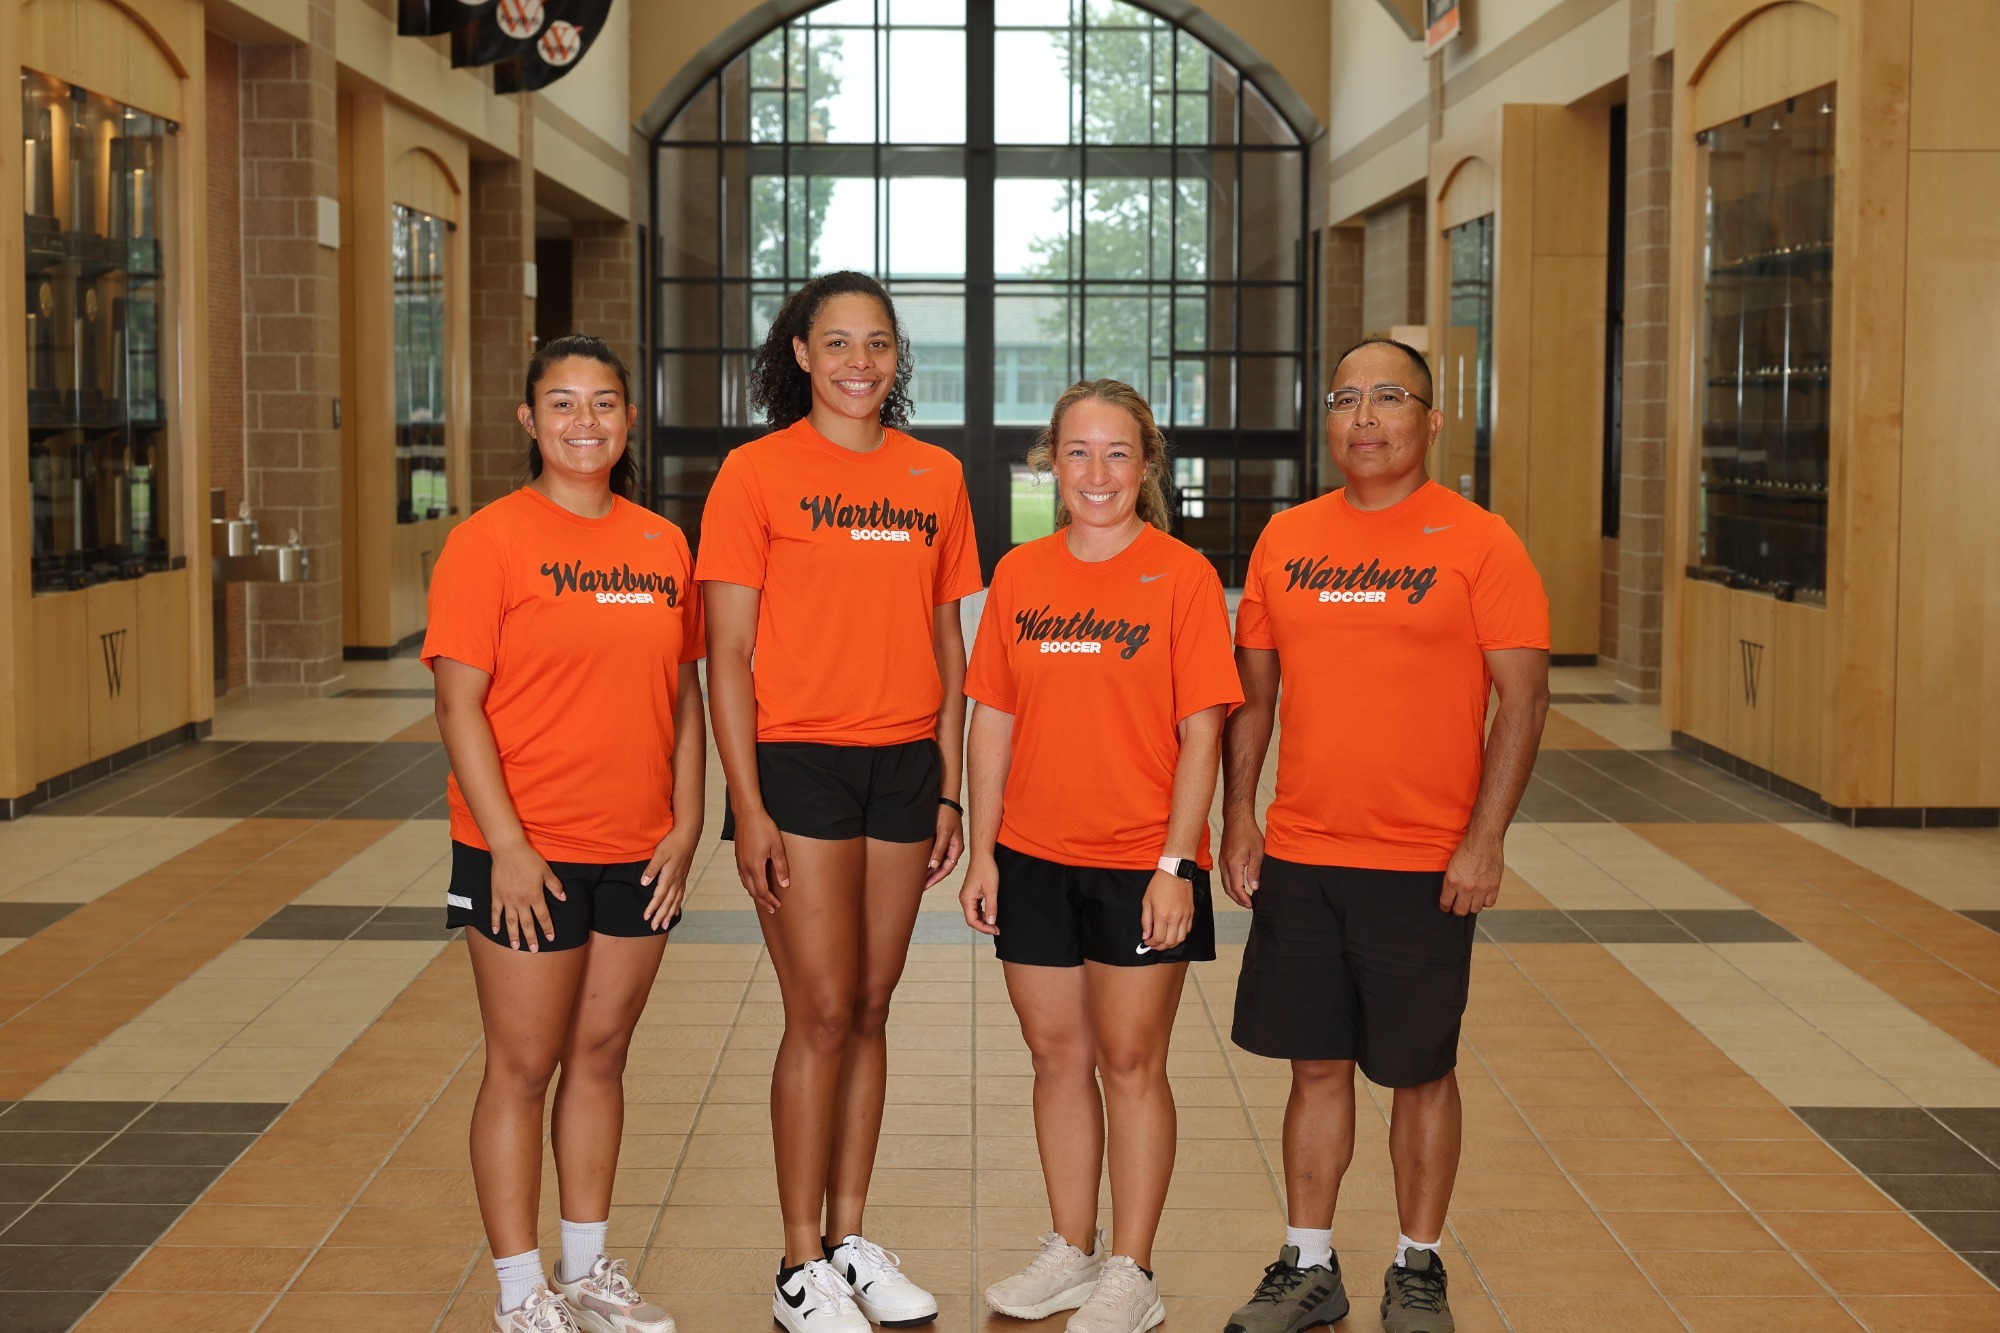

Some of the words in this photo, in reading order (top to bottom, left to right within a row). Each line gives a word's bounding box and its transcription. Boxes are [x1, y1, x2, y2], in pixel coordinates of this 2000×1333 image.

[800, 492, 939, 547] Wartburg
[850, 529, 911, 542] SOCCER
[540, 559, 679, 608] Wartburg
[595, 592, 655, 604] SOCCER
[1284, 554, 1438, 605] Wartburg
[1318, 590, 1387, 603] SOCCER
[1015, 604, 1151, 660] Wartburg
[1039, 641, 1102, 654] SOCCER
[100, 628, 127, 699] W
[1739, 639, 1764, 709] W
